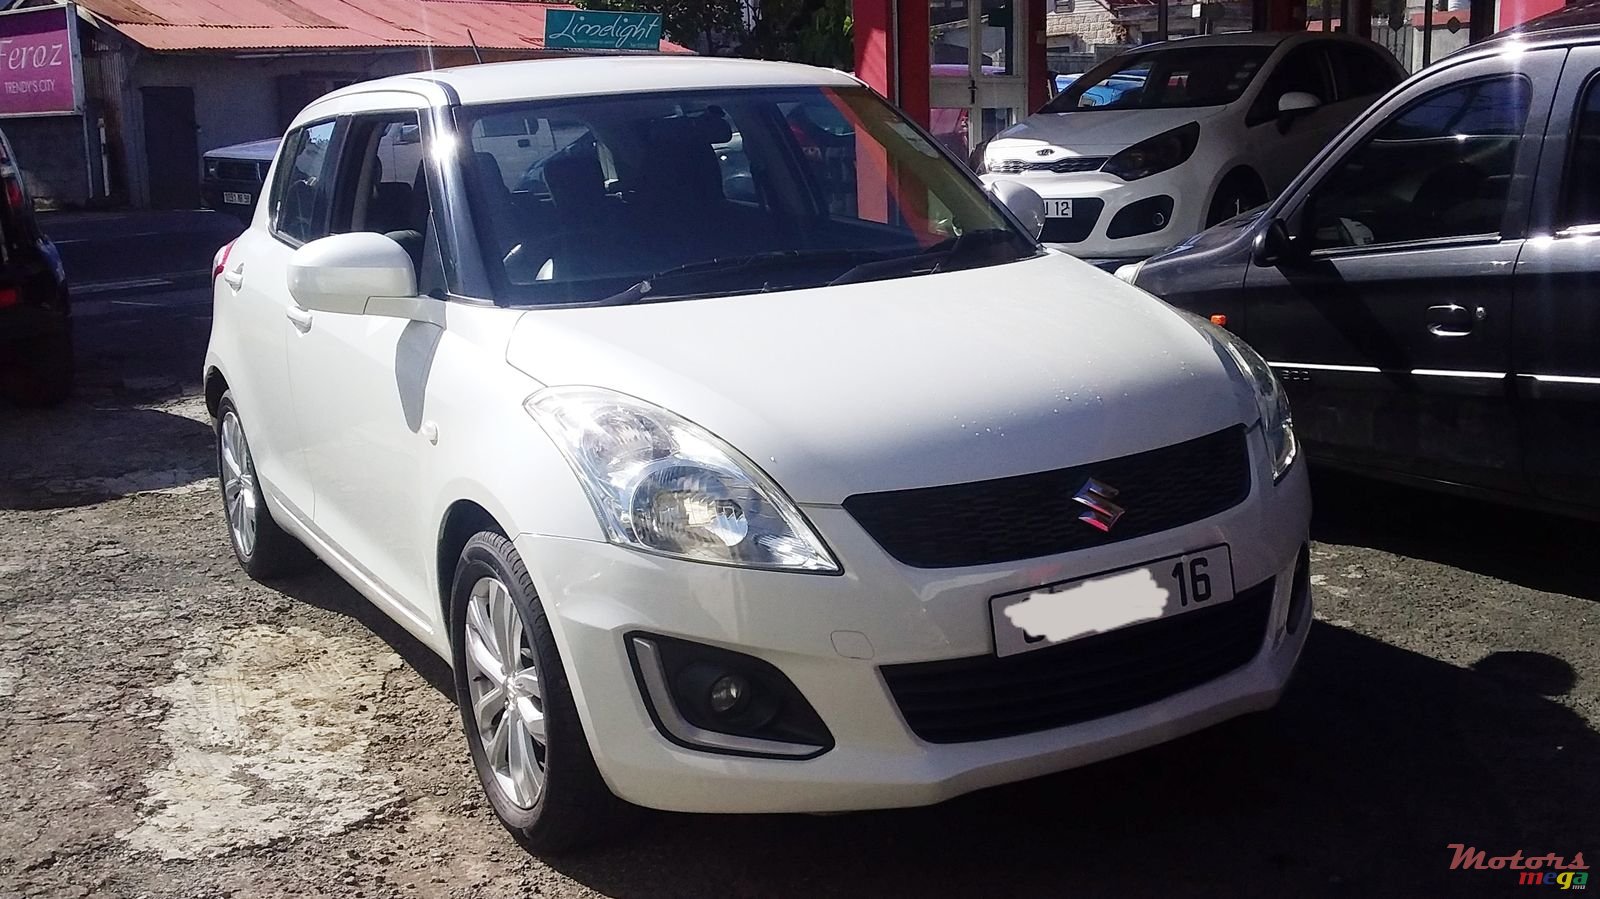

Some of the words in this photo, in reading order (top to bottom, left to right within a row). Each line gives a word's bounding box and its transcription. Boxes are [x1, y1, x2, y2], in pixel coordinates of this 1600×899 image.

[549, 13, 659, 48] Limelight
[4, 81, 38, 94] TRENDY'S
[39, 79, 55, 92] CITY
[1055, 201, 1070, 216] 12
[1171, 556, 1212, 607] 16
